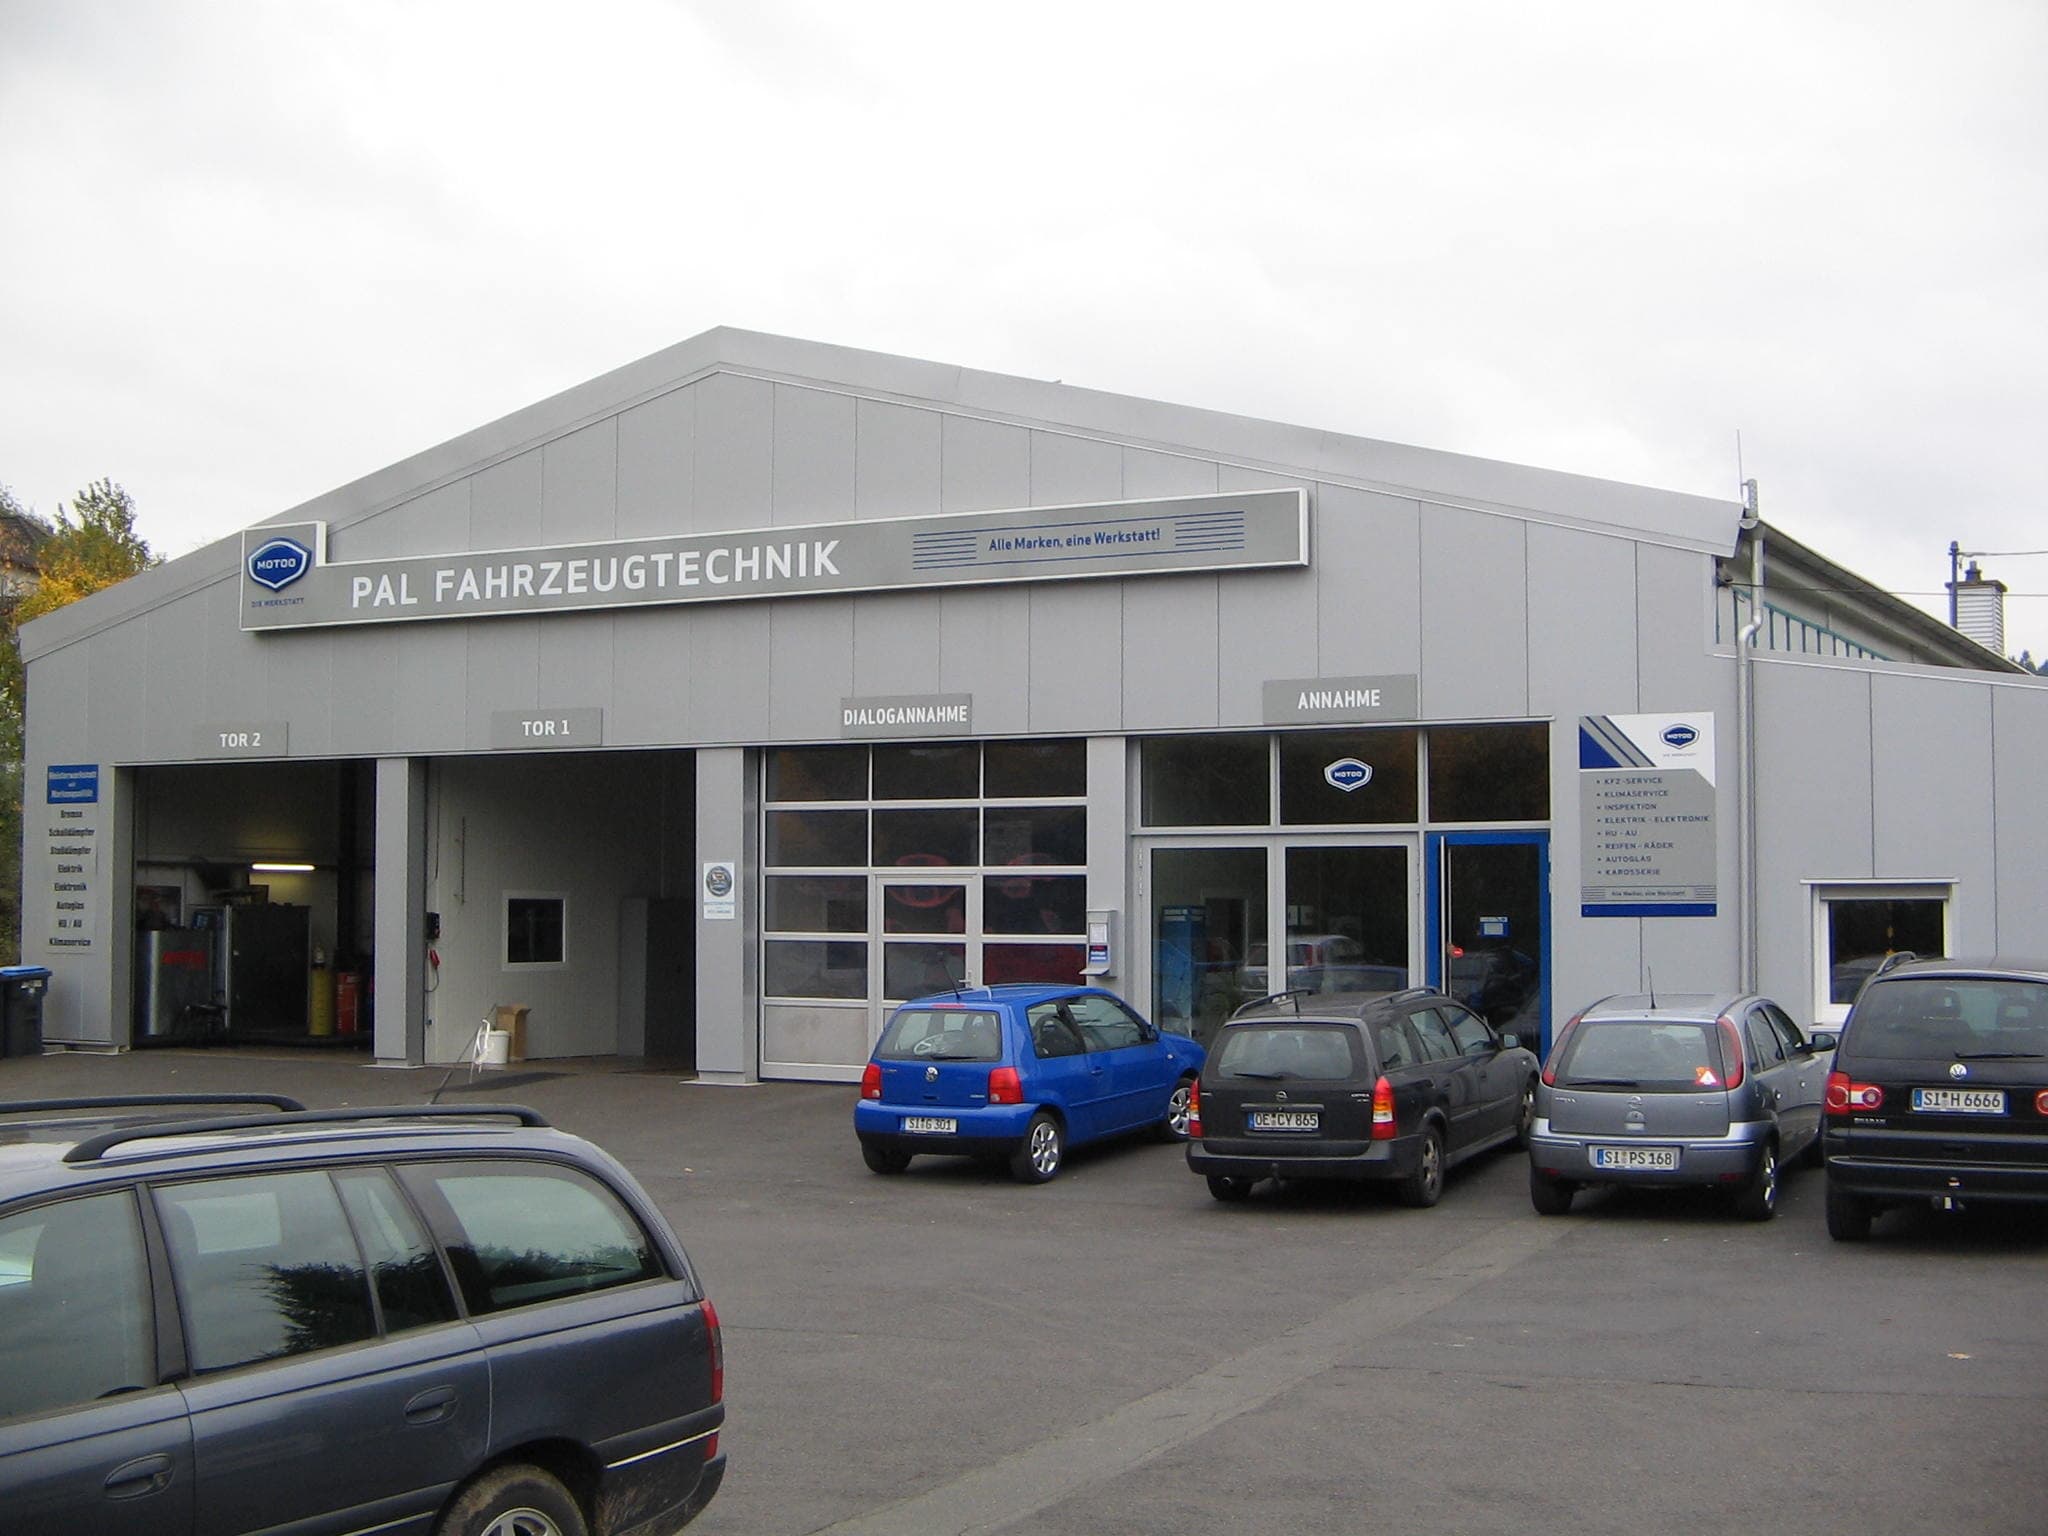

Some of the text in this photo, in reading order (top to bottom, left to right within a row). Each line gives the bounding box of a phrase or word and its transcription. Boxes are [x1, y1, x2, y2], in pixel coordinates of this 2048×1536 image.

[988, 527, 1161, 551] Alle Marken, eine Werkstatt!
[257, 558, 297, 570] MOTOO
[352, 540, 841, 609] PAL FAHRZEUGTECHNIK
[1297, 688, 1381, 710] ANNAHME
[843, 705, 968, 726] DIALOGANNAHME
[521, 719, 570, 737] TOR 1
[219, 732, 261, 748] TOR 2
[1334, 770, 1363, 779] MOTOO
[1604, 803, 1657, 811] INSPEKTION
[1604, 816, 1646, 824] ELEKTRIK
[1654, 815, 1709, 823] ELEKTRONIK
[1605, 855, 1652, 863] AUTOGLAS
[1605, 868, 1660, 876] KAROSSERIE
[1923, 1093, 2001, 1108] SI H 6666
[908, 1118, 919, 1129] SI
[935, 1119, 952, 1131] 301
[1255, 1114, 1318, 1127] OE CY 865
[1604, 1151, 1673, 1166] SI PS 168
